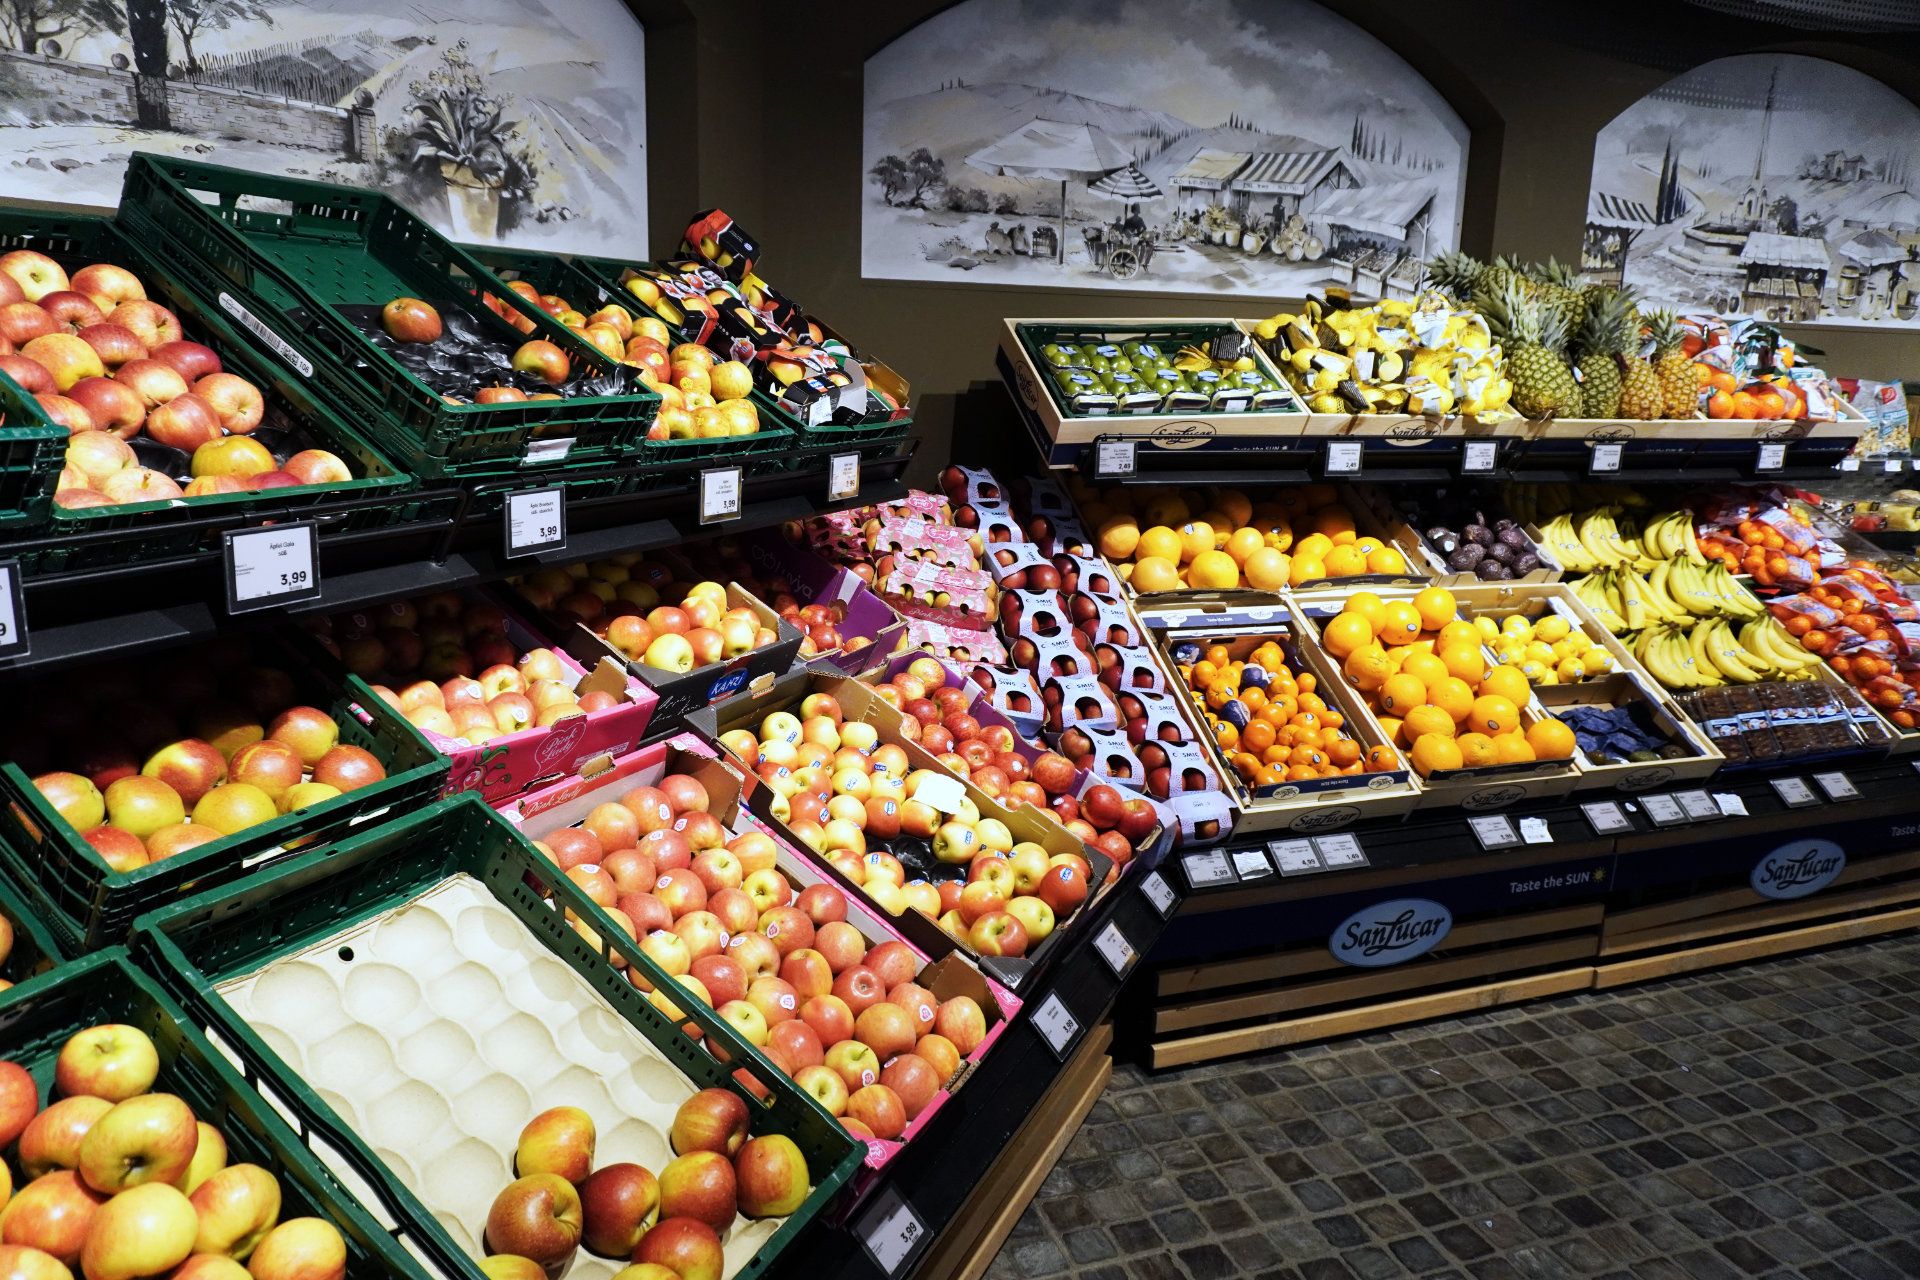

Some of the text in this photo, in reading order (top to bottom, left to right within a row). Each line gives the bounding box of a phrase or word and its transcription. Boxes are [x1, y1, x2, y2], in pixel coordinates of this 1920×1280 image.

[540, 525, 557, 538] 3,99
[280, 570, 307, 587] 3,99
[908, 608, 959, 625] Pink Lady
[1041, 639, 1070, 649] CSMIC
[1065, 682, 1095, 690] CSMIC
[542, 728, 578, 755] Pink
[1097, 739, 1126, 747] CSMIC
[541, 740, 576, 763] Lady
[526, 799, 556, 815] Pink
[1294, 809, 1357, 830] SanLucar
[1759, 849, 1841, 890] SanLucar
[1509, 871, 1591, 893] Taste the SUN
[1341, 909, 1445, 957] SanLucar
[900, 1222, 917, 1243] 3,99
